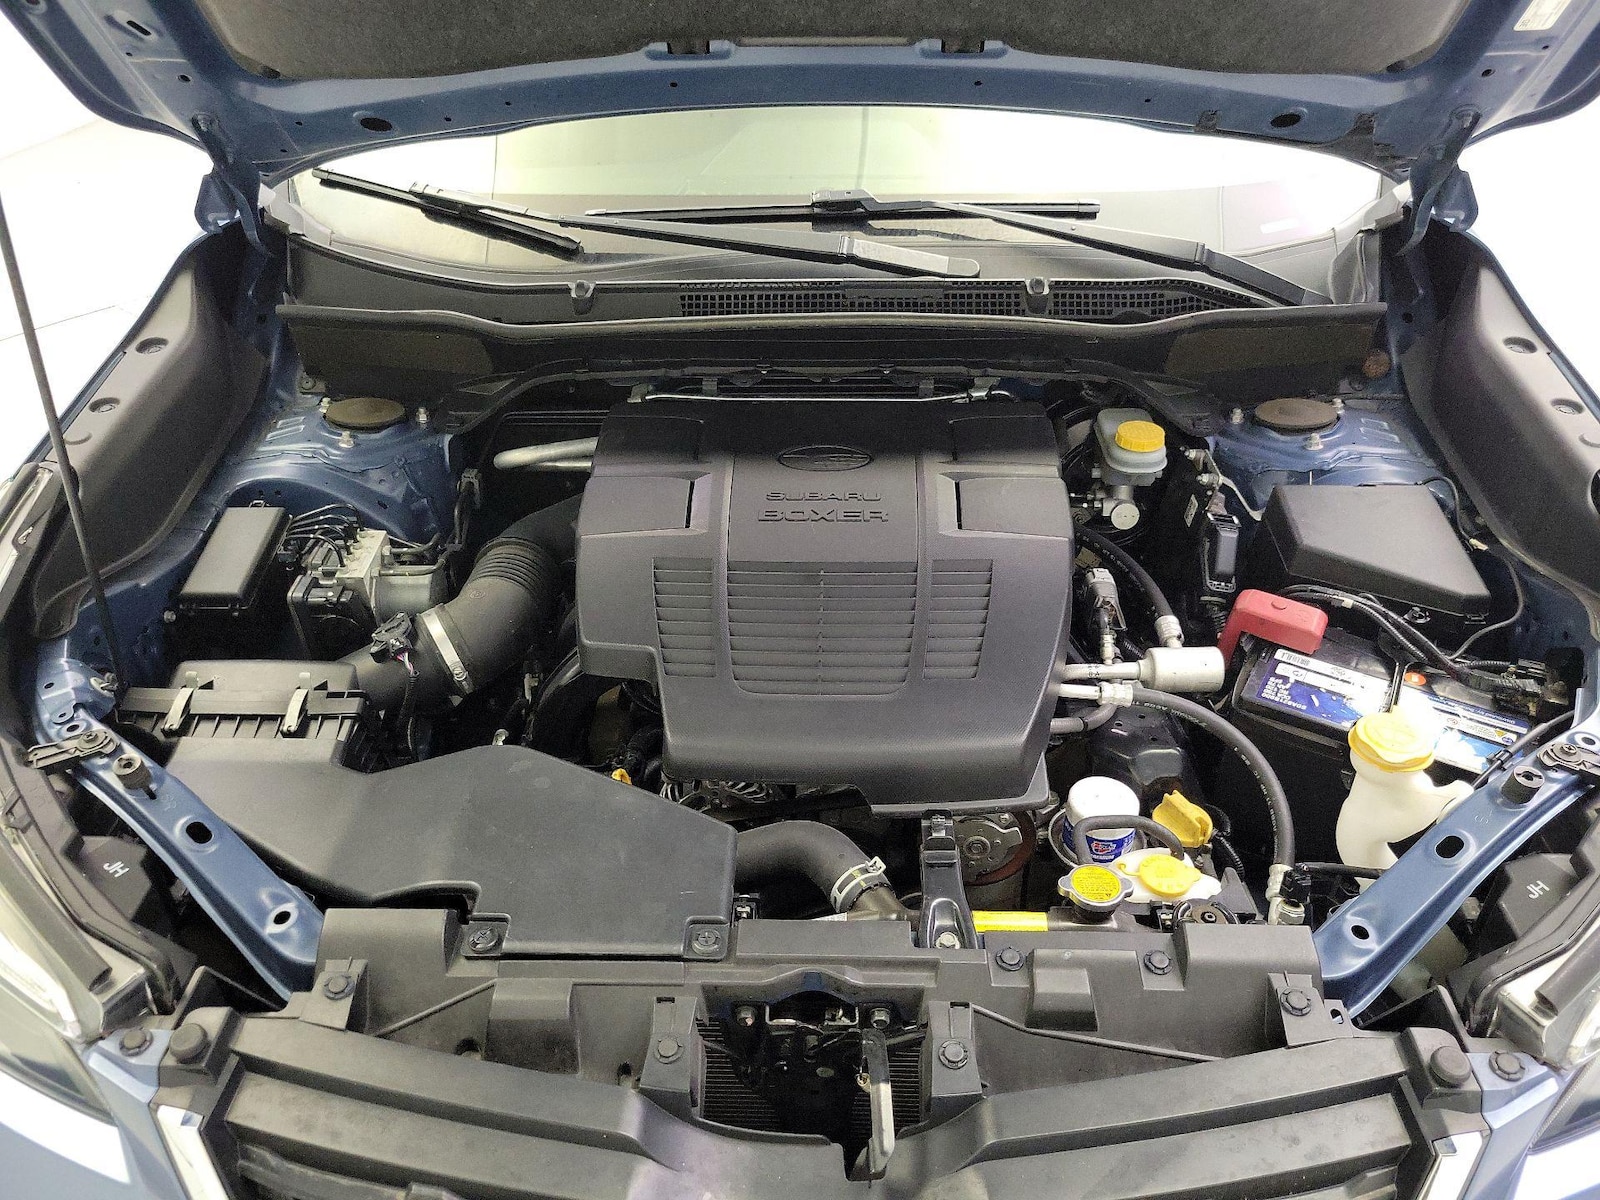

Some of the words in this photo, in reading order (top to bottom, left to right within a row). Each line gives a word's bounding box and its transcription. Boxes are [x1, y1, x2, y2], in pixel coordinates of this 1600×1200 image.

[766, 491, 881, 502] SUBARU
[758, 509, 889, 522] BOXER
[103, 861, 130, 878] JH
[1526, 880, 1550, 899] JH
